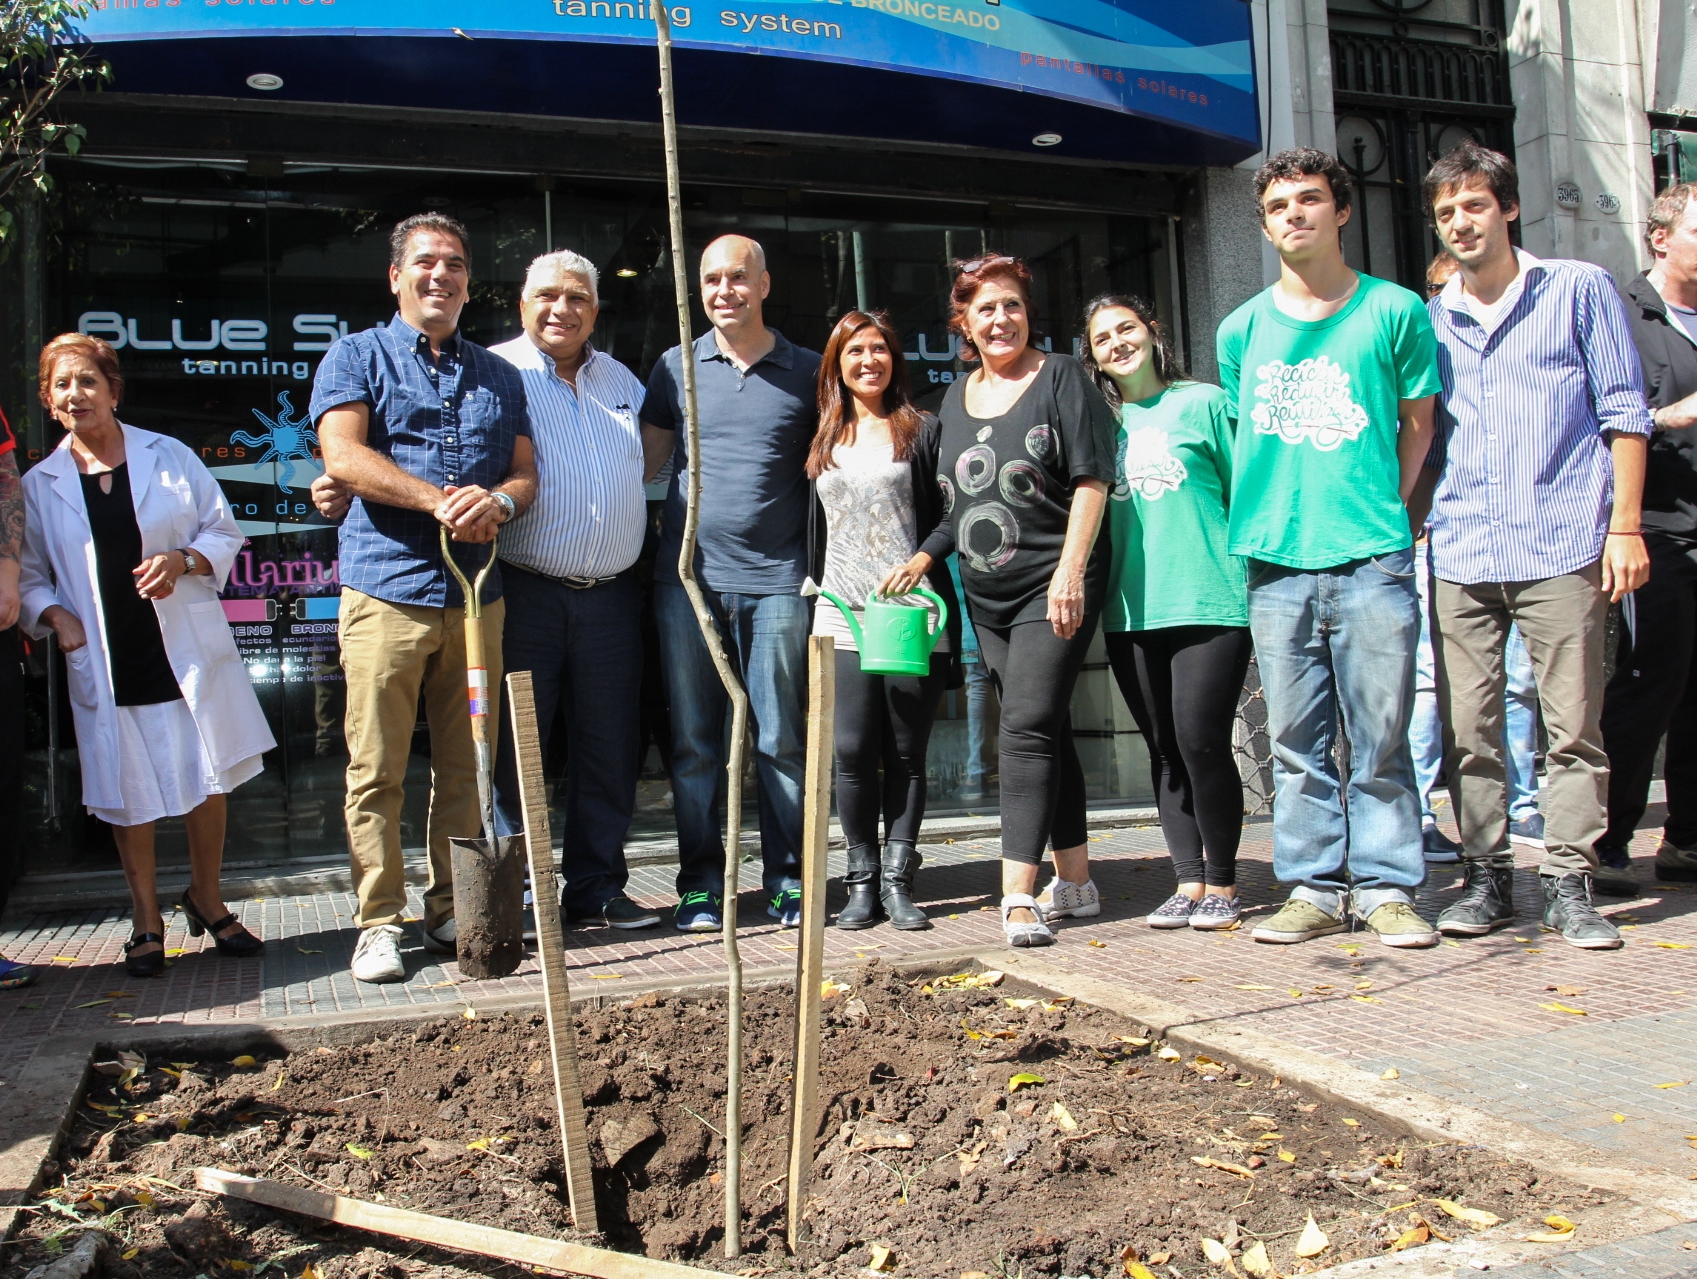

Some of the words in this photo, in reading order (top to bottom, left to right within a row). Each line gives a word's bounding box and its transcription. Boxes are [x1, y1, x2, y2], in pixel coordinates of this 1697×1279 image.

[720, 10, 842, 39] system
[1020, 51, 1125, 84] pantallas
[1138, 77, 1209, 106] solares
[182, 358, 309, 379] tanning
[201, 446, 246, 459] res
[231, 503, 258, 515] ro
[276, 499, 307, 515] de
[230, 551, 341, 587] llariu
[291, 623, 340, 634] BRON
[236, 637, 272, 645] fectos
[282, 635, 338, 643] ecundario
[240, 647, 261, 655] ibre
[265, 646, 278, 654] de
[282, 645, 336, 653] molestias
[243, 656, 260, 664] No
[307, 655, 326, 663] piel
[292, 665, 321, 673] dolor
[290, 675, 303, 683] de
[307, 673, 345, 682] inactiv
